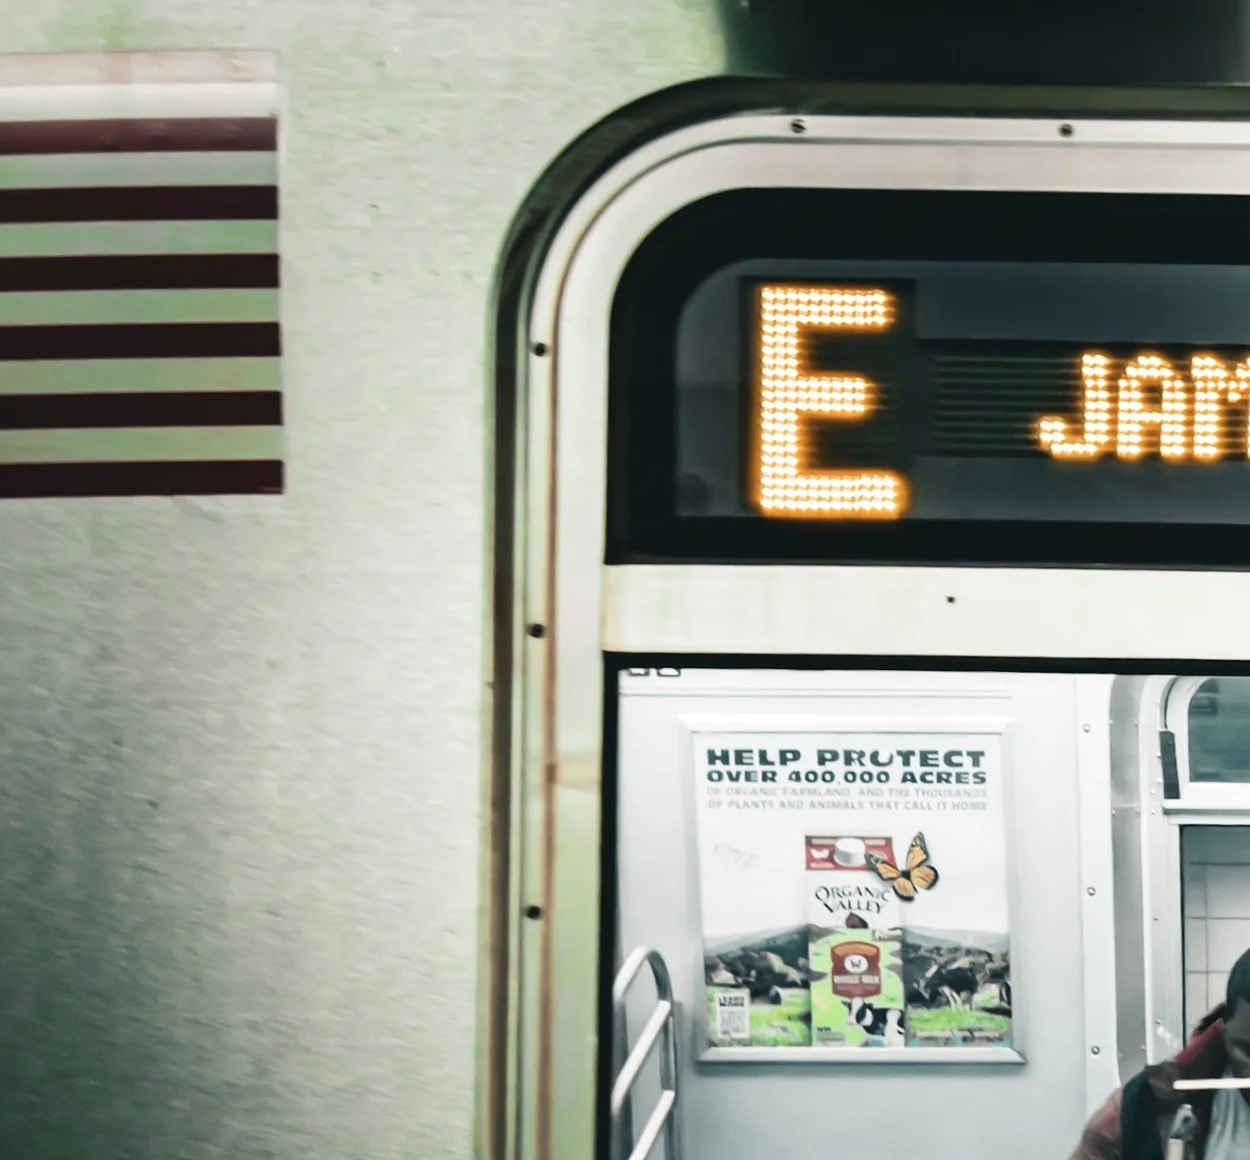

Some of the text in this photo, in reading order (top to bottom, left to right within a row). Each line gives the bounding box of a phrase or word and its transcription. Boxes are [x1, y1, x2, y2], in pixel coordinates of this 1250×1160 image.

[757, 283, 907, 515] E
[706, 749, 985, 768] HELP PROTECT
[706, 770, 778, 783] OVER
[901, 771, 987, 785] ACRES
[726, 787, 778, 797] ORGANIC
[858, 787, 884, 798] AND
[888, 787, 909, 798] THE
[914, 788, 987, 798] THOUSANDS
[708, 799, 987, 811] OF PLANTS AND ANIMALS THAT CALL IT HOME
[815, 885, 892, 902] ORGANIC
[823, 899, 882, 914] VALLEY
